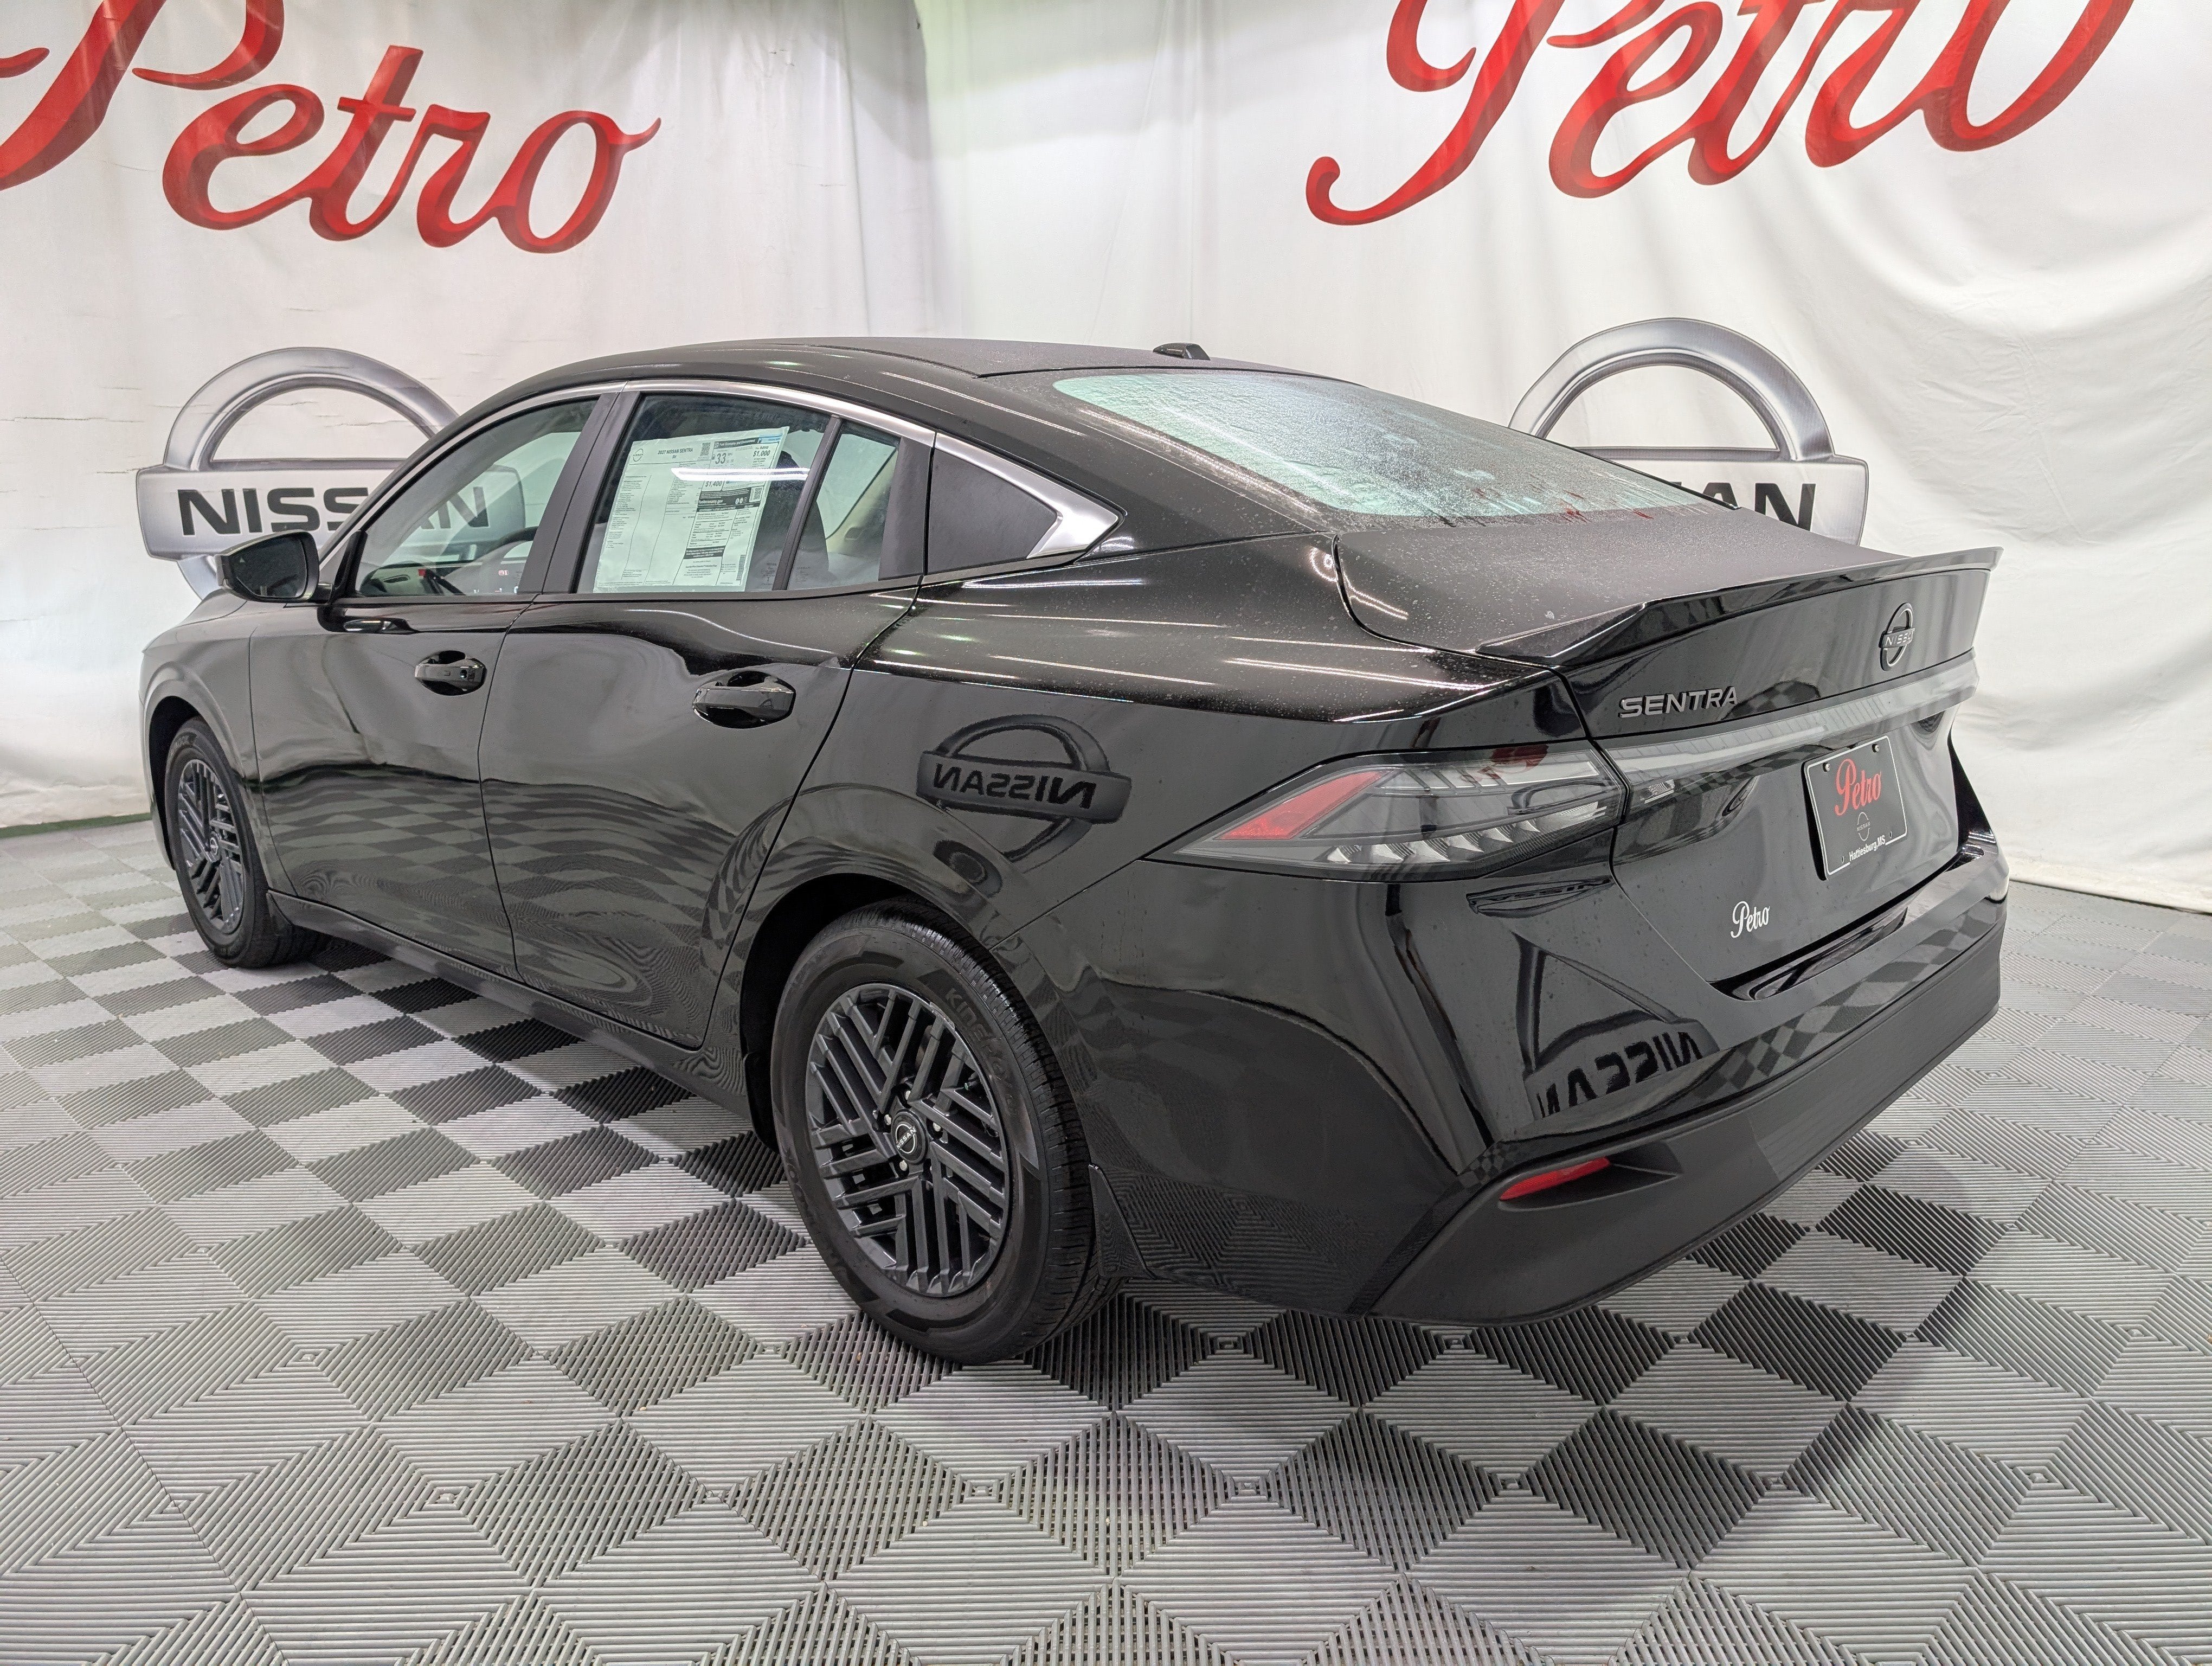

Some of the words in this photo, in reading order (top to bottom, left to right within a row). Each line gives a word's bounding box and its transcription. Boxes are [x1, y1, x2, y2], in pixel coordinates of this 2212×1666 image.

[715, 452, 726, 465] 33
[177, 488, 490, 536] NISSN
[1618, 685, 1738, 718] SENTRA
[1834, 758, 1882, 816] Petro
[1856, 822, 1870, 832] NISSAN
[1730, 901, 1770, 938] Petro
[896, 1127, 917, 1149] NISSAN
